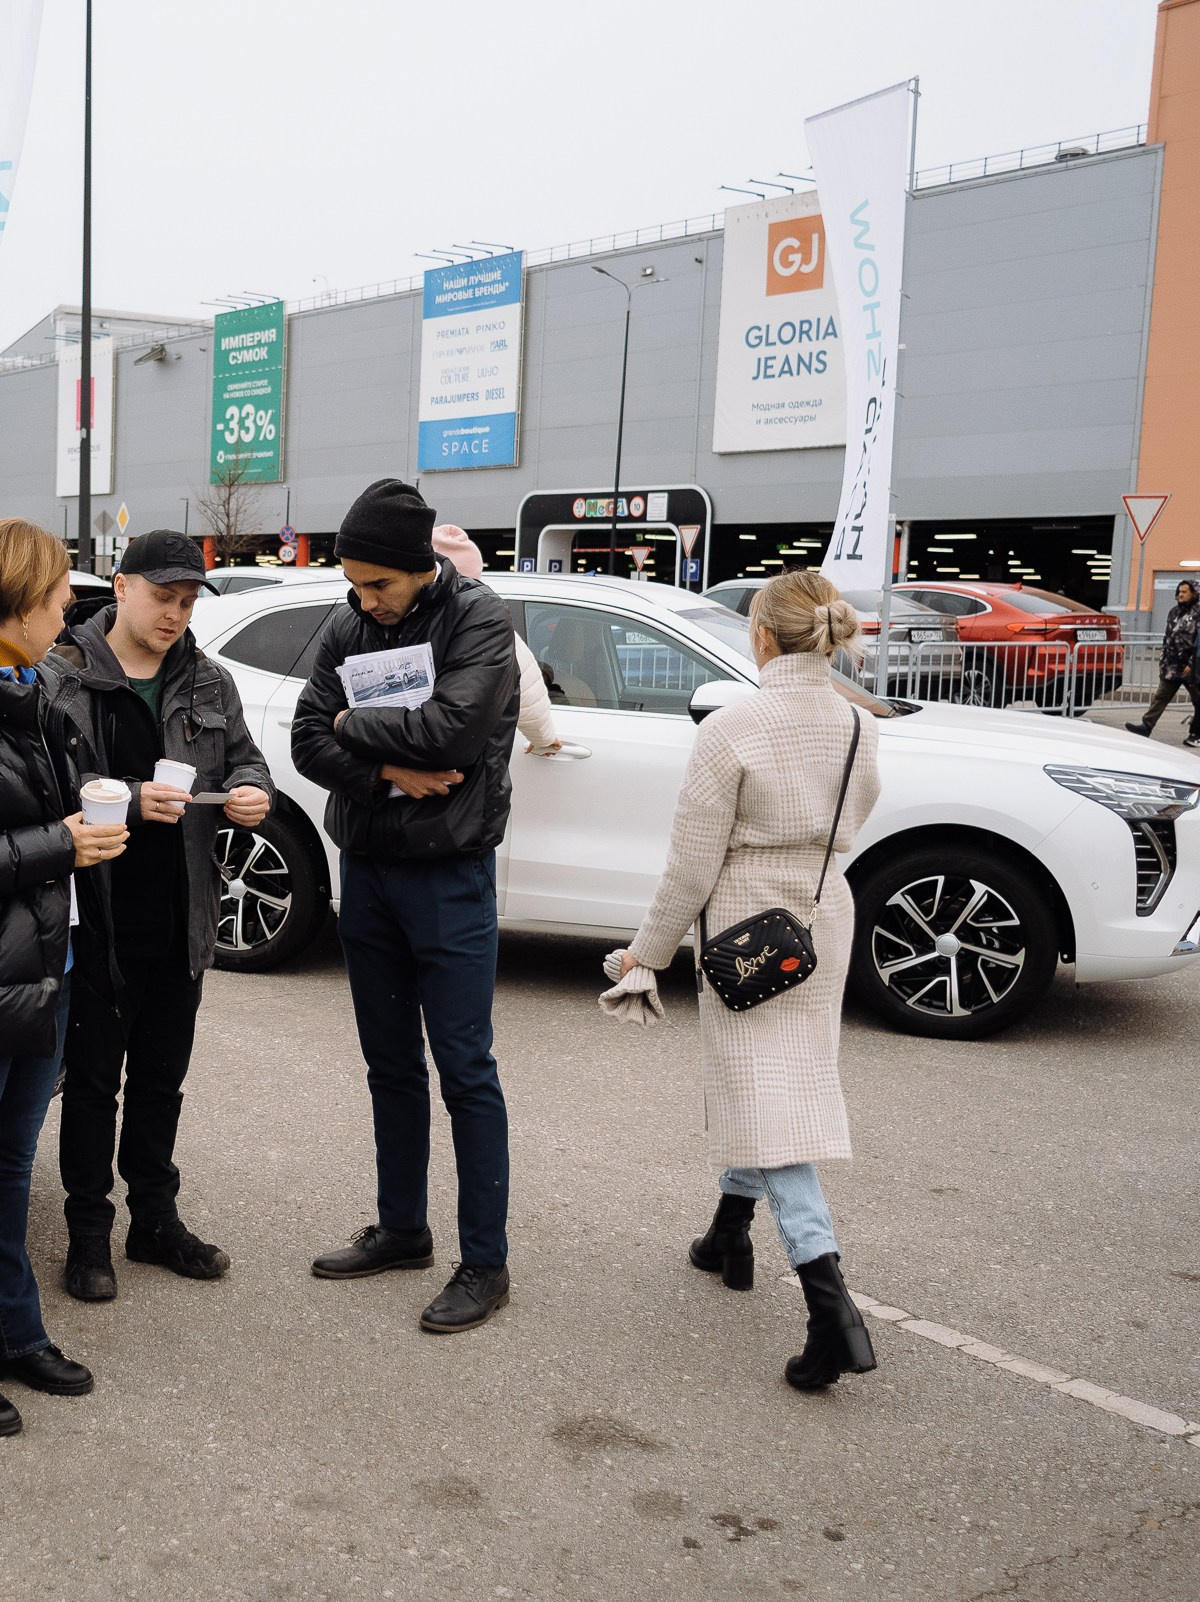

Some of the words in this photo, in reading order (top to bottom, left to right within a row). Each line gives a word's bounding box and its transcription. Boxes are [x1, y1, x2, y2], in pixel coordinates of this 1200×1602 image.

[772, 232, 819, 277] GJ
[443, 276, 468, 291] НАШИ
[469, 270, 502, 286] ЛУЧШИЕ
[435, 289, 474, 304] МИРОВЫЕ
[476, 321, 506, 334] PINKO
[745, 315, 838, 348] GLORIA
[221, 328, 277, 351] ИМПЕРИЯ
[228, 347, 268, 365] СУМОК
[752, 350, 828, 381] JEANS
[430, 391, 480, 406] PARAJUMPERS
[485, 387, 505, 400] DIESEL
[752, 402, 785, 412] Модная
[788, 398, 823, 411] одежда
[764, 414, 817, 427] аксессуары
[441, 439, 489, 456] SPACE
[634, 503, 641, 512] 10
[282, 550, 292, 558] 20
